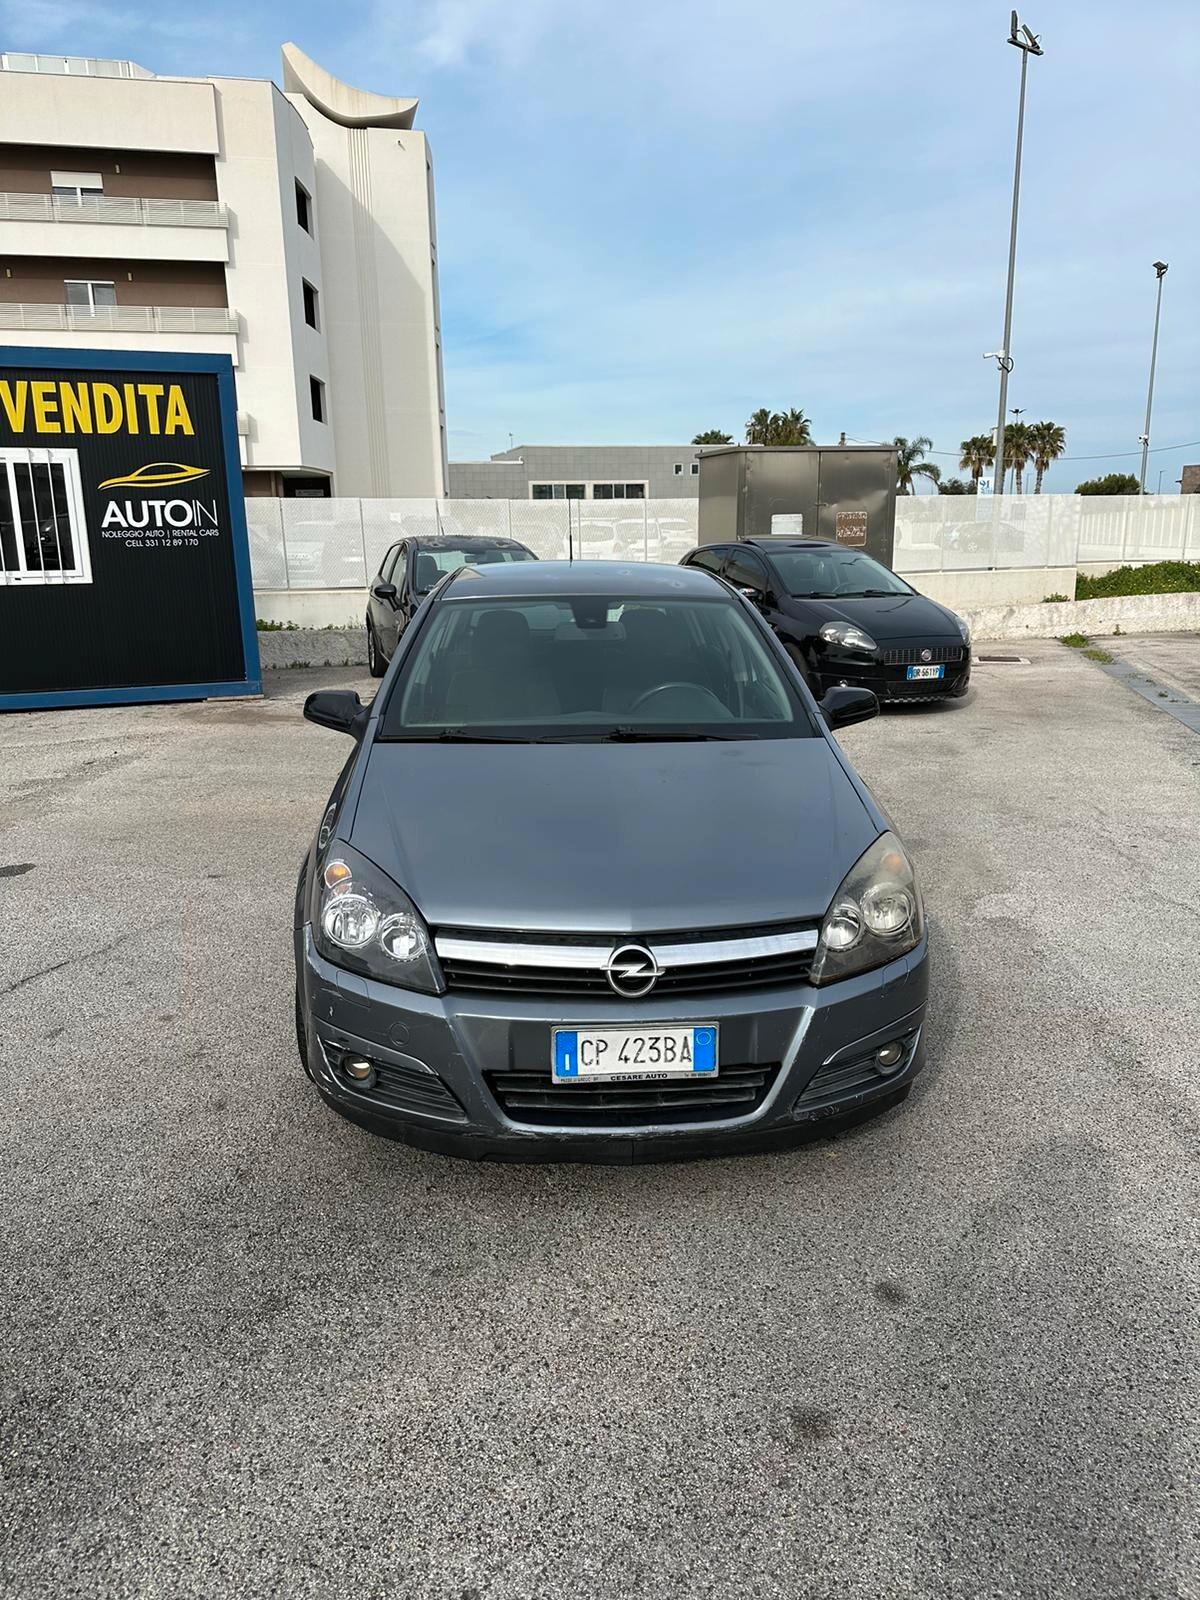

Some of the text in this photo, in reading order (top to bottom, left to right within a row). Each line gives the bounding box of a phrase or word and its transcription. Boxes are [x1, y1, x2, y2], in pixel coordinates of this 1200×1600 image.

[0, 380, 195, 435] VENDITA
[101, 499, 218, 528] AUTOIN
[101, 530, 144, 538] NOLEGGIO
[172, 529, 198, 537] RENTAL
[125, 539, 143, 547] CELL
[145, 539, 158, 547] 331
[162, 539, 171, 547] 12
[185, 538, 199, 546] 170
[581, 1038, 608, 1066] CP
[618, 1036, 692, 1064] 423BA
[610, 1072, 668, 1081] CESARE AUTO
